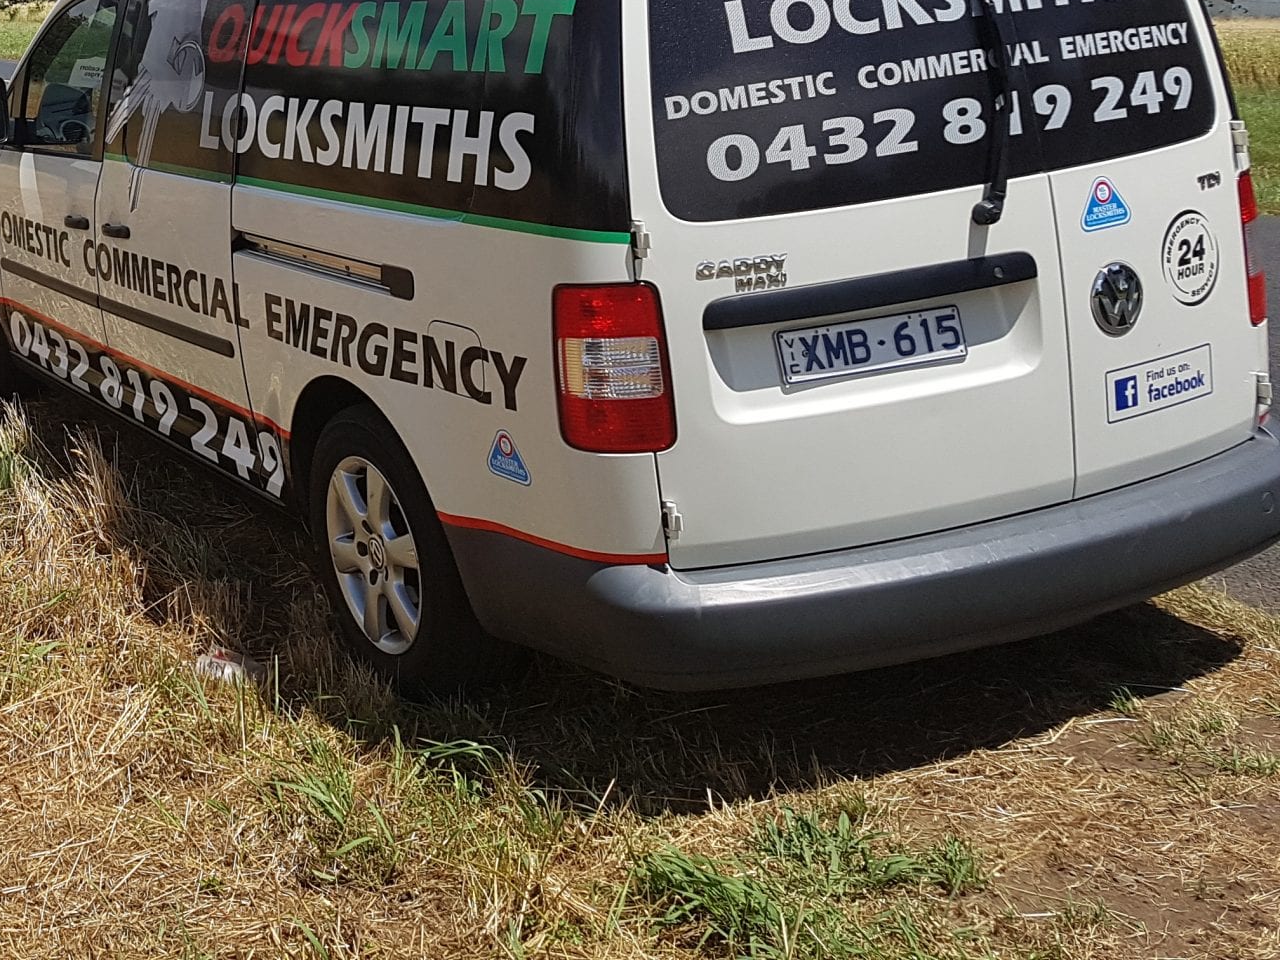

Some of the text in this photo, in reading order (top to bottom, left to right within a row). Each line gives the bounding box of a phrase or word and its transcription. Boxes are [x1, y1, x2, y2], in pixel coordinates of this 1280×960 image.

[664, 70, 837, 120] DOMESTIC
[1059, 22, 1189, 59] EMERGENCY
[199, 90, 536, 191] LOCKSMITHS
[705, 66, 1193, 182] 0432 819 249
[1166, 217, 1201, 264] EMERGENCY
[1177, 234, 1206, 267] 24
[695, 253, 788, 281] CADDY
[735, 272, 788, 293] MAXI
[1177, 263, 1205, 281] HOUR
[83, 239, 250, 329] COMMERCIAL
[264, 293, 528, 411] EMERGENCY
[1146, 367, 1164, 382] Find
[1166, 366, 1176, 376] us
[1147, 370, 1205, 402] facebook
[10, 311, 285, 498] 0432 819 249
